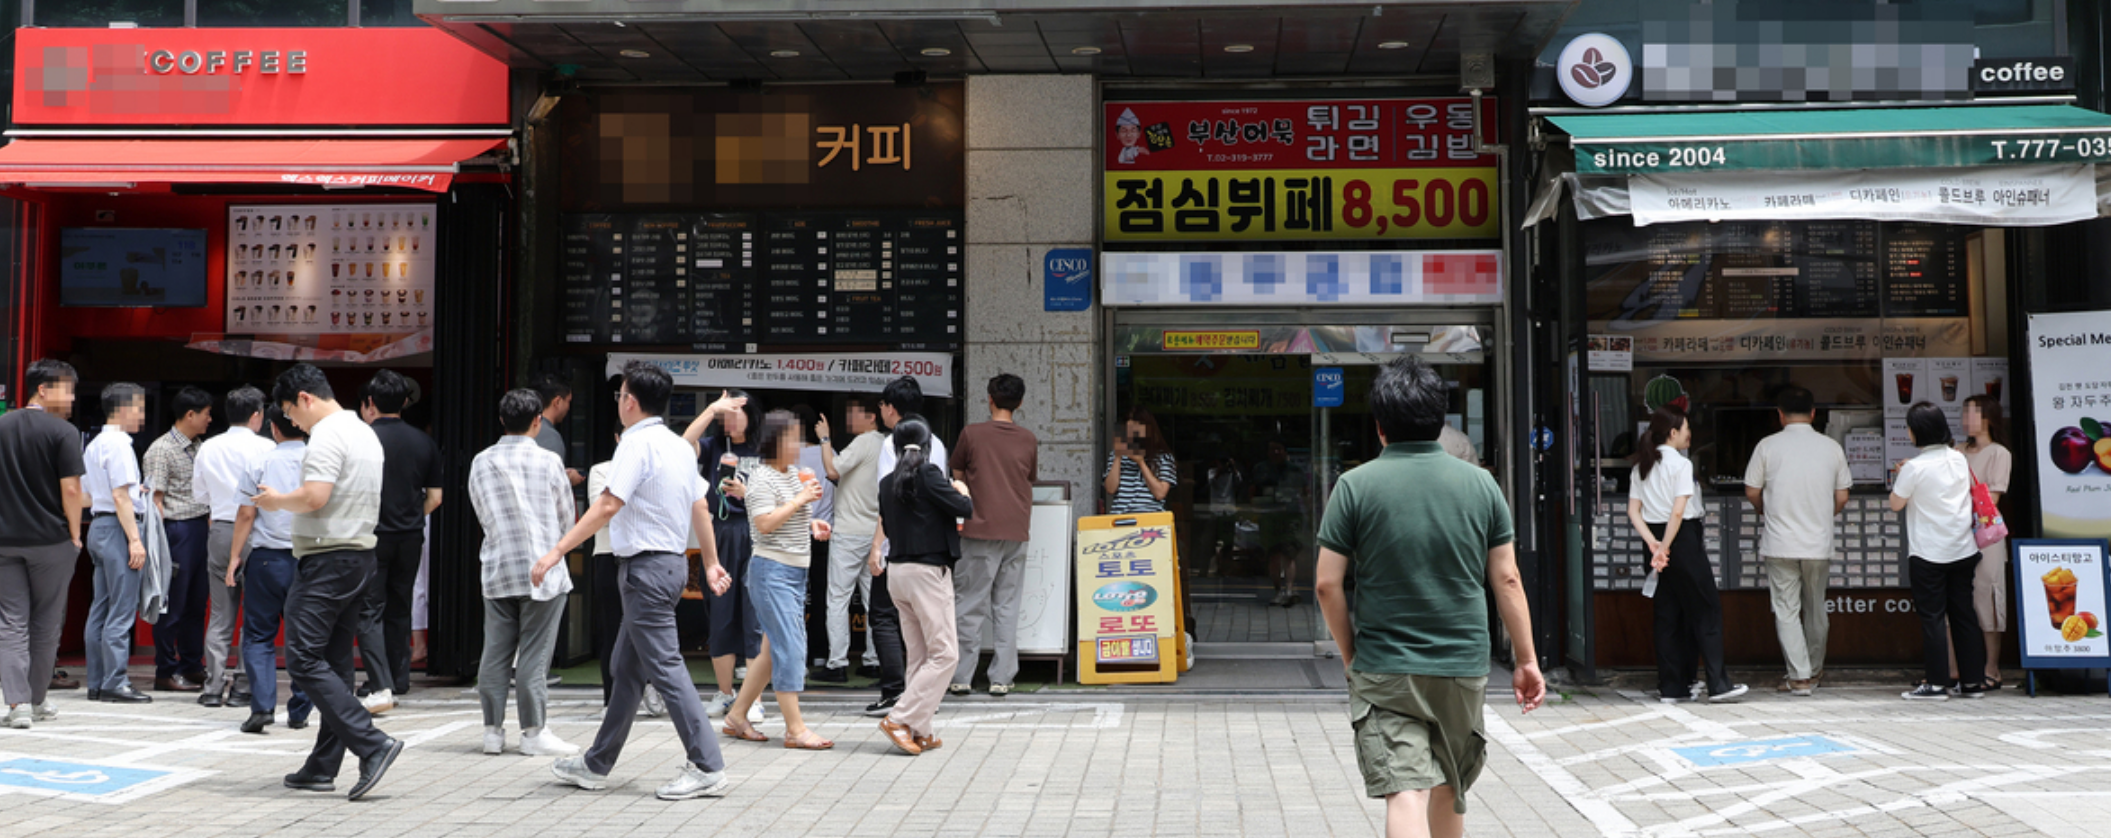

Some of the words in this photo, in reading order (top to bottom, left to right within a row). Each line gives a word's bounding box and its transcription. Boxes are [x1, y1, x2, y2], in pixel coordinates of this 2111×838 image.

[150, 49, 308, 75] COFFEE
[1980, 62, 2065, 82] coffee
[1306, 105, 1381, 131] 튀김
[1405, 103, 1474, 130] 우동
[1187, 118, 1294, 145] 부산어묵
[815, 122, 911, 171] 커피
[1306, 134, 1380, 161] 라면
[1405, 133, 1479, 160] 김밥
[1593, 148, 1660, 168] since
[1668, 146, 1726, 167] 2004
[1115, 176, 1333, 233] 점심뷔페
[1341, 178, 1489, 236] 8,500
[1667, 197, 1731, 211] 아메리카노
[1939, 187, 1986, 206] 콜드브루
[1049, 258, 1088, 272] CESCO
[1820, 334, 1866, 351] 콜드브루
[2038, 333, 2086, 349] Special
[707, 359, 772, 370] 아메리카노
[1095, 559, 1157, 578] 토토
[1096, 615, 1159, 634] 로또
